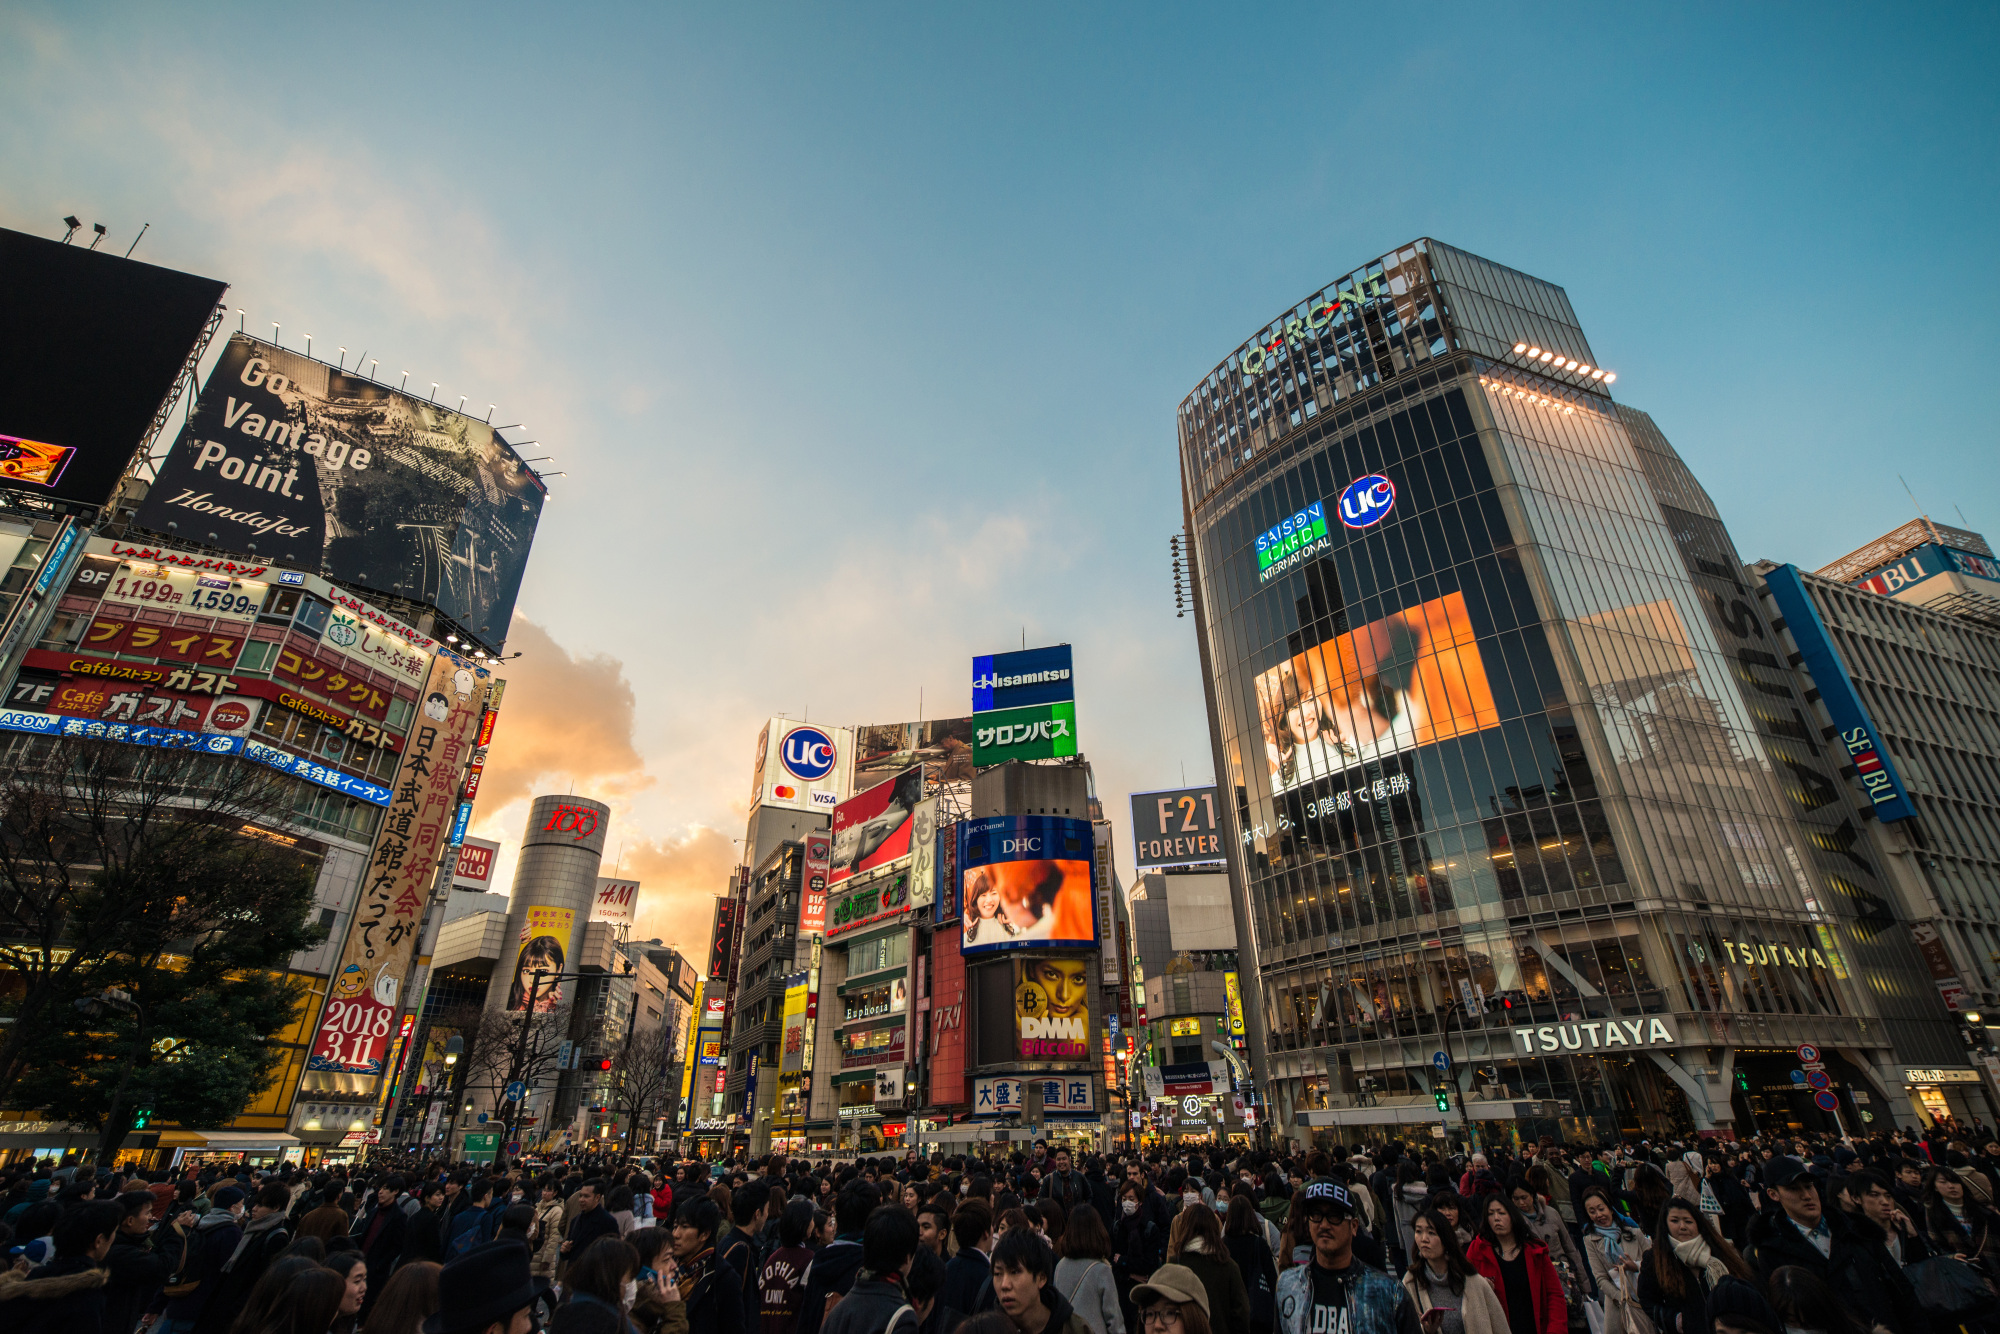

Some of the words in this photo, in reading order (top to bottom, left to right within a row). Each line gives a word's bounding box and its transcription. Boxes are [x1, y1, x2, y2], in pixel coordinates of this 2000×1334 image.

[222, 397, 373, 471] Vantage
[193, 441, 305, 500] Point.
[165, 489, 311, 539] HondaJet
[1343, 481, 1390, 518] UC
[1258, 504, 1320, 551] SAISON
[1268, 528, 1313, 560] CARD
[111, 542, 267, 578] しゃぶしゃぶバイキング
[1260, 536, 1330, 583] INTERNATONAL
[1950, 552, 2000, 579] SEIB
[78, 569, 111, 585] 9F
[114, 577, 184, 603] 1,199円
[1869, 557, 1929, 595] IBU
[191, 588, 259, 614] 1,599円
[329, 587, 435, 648] しゃぶしゃぶバイキング
[89, 621, 235, 660] プライス
[361, 633, 425, 677] しゃぶ葉
[13, 682, 55, 702] 7F
[163, 669, 238, 695] ガスト
[277, 650, 385, 710] コンタクト
[61, 688, 104, 705] Café
[101, 691, 201, 726] ガスト
[0, 713, 49, 729] AEON
[345, 718, 395, 750] ガスト
[976, 719, 1070, 747] サロンパス
[787, 739, 832, 768] UC
[1842, 727, 1897, 805] SEIBU
[294, 759, 391, 802] 英会話イーオン
[558, 804, 599, 816] SHIBUYA
[813, 793, 836, 804] VISA
[385, 703, 476, 947] 打首獄門同好会が
[542, 810, 598, 840] 109
[980, 821, 1005, 832] Channel
[1158, 794, 1216, 834] F21
[359, 725, 437, 959] 日本武道館だって。
[462, 848, 486, 863] UNI
[1002, 837, 1041, 854] DHC
[1139, 835, 1220, 860] FOREVER
[458, 862, 485, 877] QLO
[1096, 840, 1110, 891] Taisei
[597, 884, 635, 906] H&M
[1100, 896, 1112, 940] neon
[1724, 942, 1827, 969] TSUTAYA
[322, 1001, 392, 1037] 2018
[846, 1003, 888, 1019] Euphoria
[891, 1029, 904, 1046] JTB
[1021, 1017, 1086, 1040] DMM
[1516, 1018, 1674, 1054] TSUTAYA
[323, 1032, 374, 1066] 3.11
[1021, 1040, 1086, 1056] Bitcoin
[1905, 1070, 1946, 1081] TSUTAYA
[694, 1117, 727, 1129] グルメタウン
